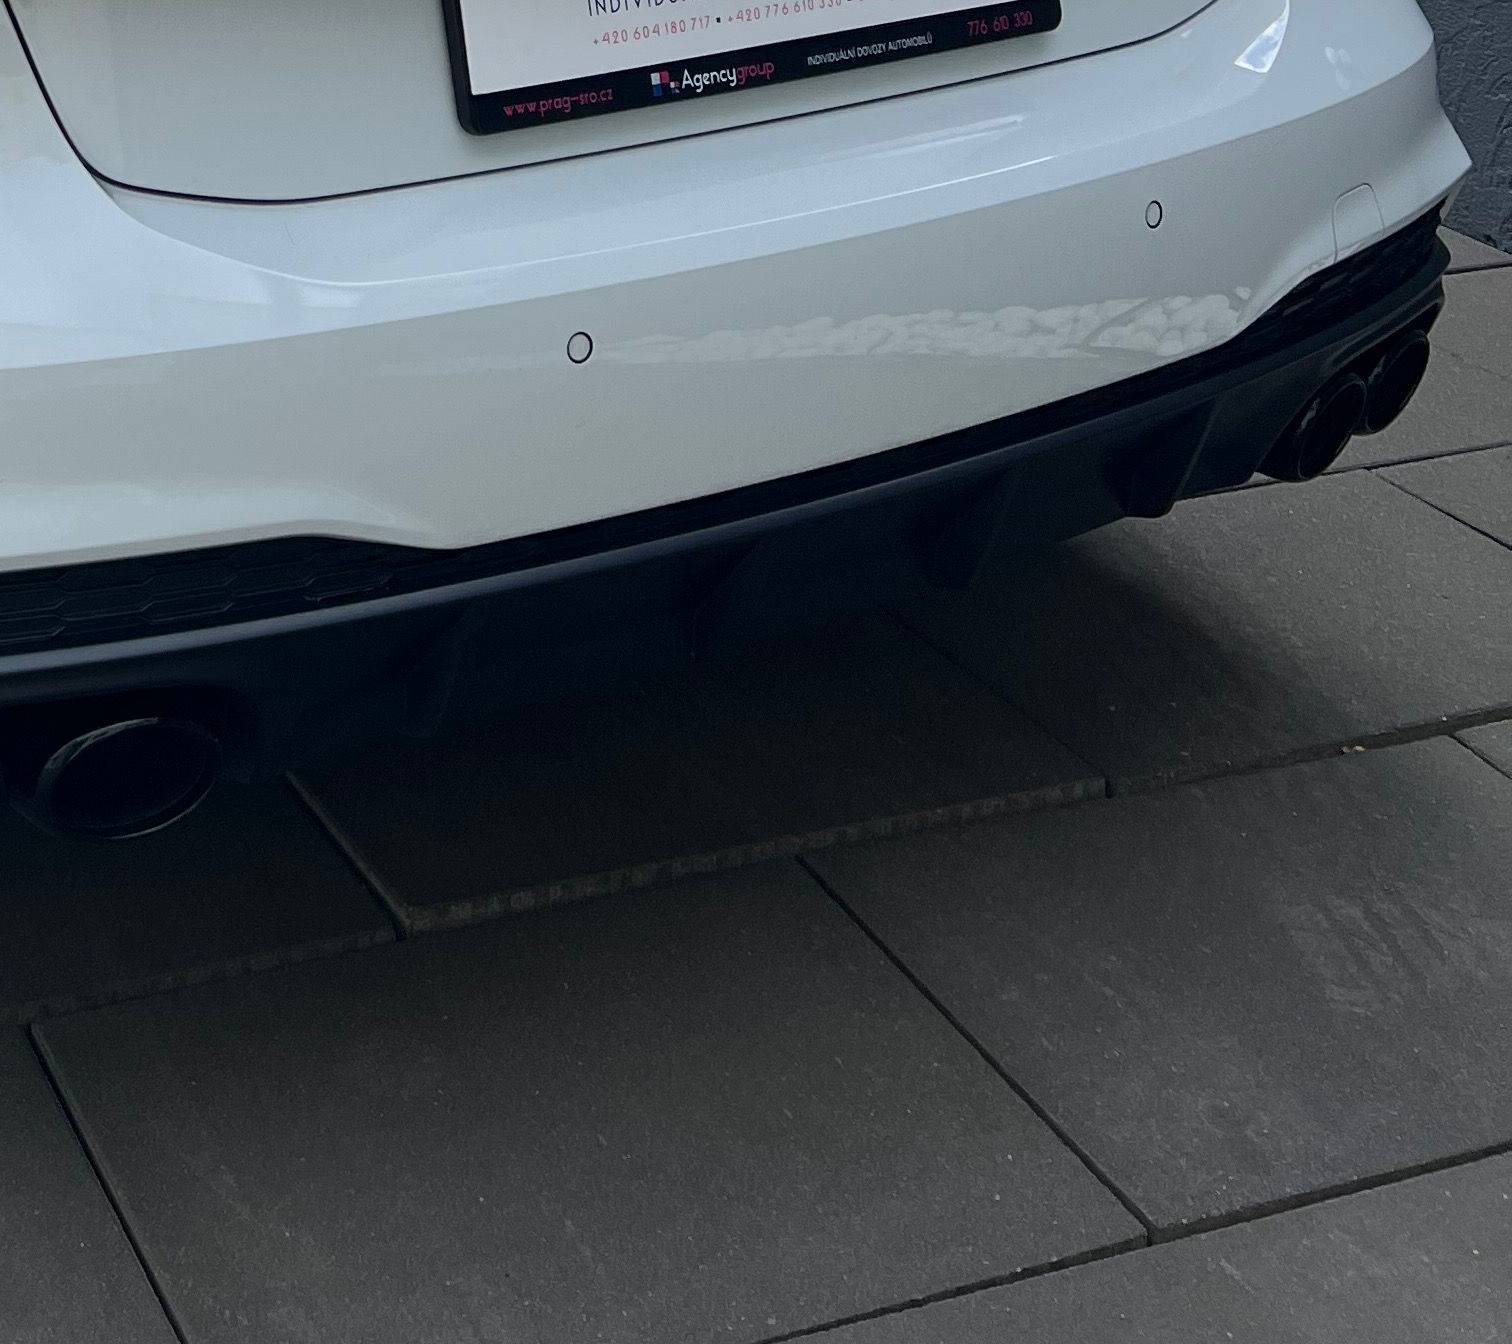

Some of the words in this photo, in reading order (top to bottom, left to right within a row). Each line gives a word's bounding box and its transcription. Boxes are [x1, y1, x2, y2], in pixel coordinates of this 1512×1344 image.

[764, 1, 789, 19] 776
[967, 18, 989, 37] 776
[856, 42, 887, 58] DOVOZY
[681, 62, 775, 93] Agencygroup
